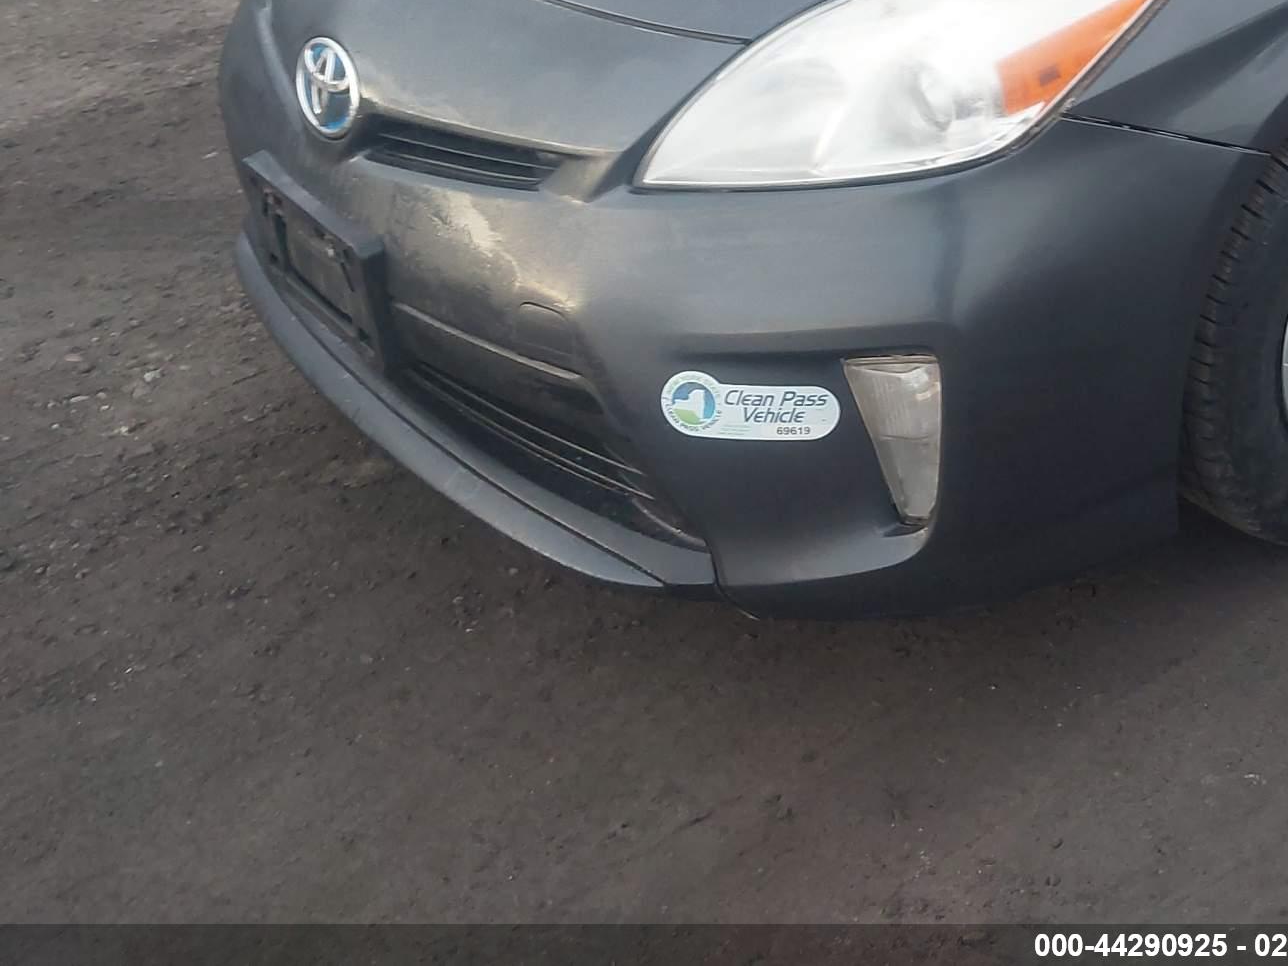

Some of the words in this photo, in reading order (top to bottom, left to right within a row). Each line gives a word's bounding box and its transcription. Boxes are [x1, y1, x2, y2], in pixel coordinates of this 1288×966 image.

[724, 389, 774, 407] Clean
[780, 391, 829, 407] Pass
[743, 407, 806, 424] Vehicle
[776, 426, 811, 435] 69619
